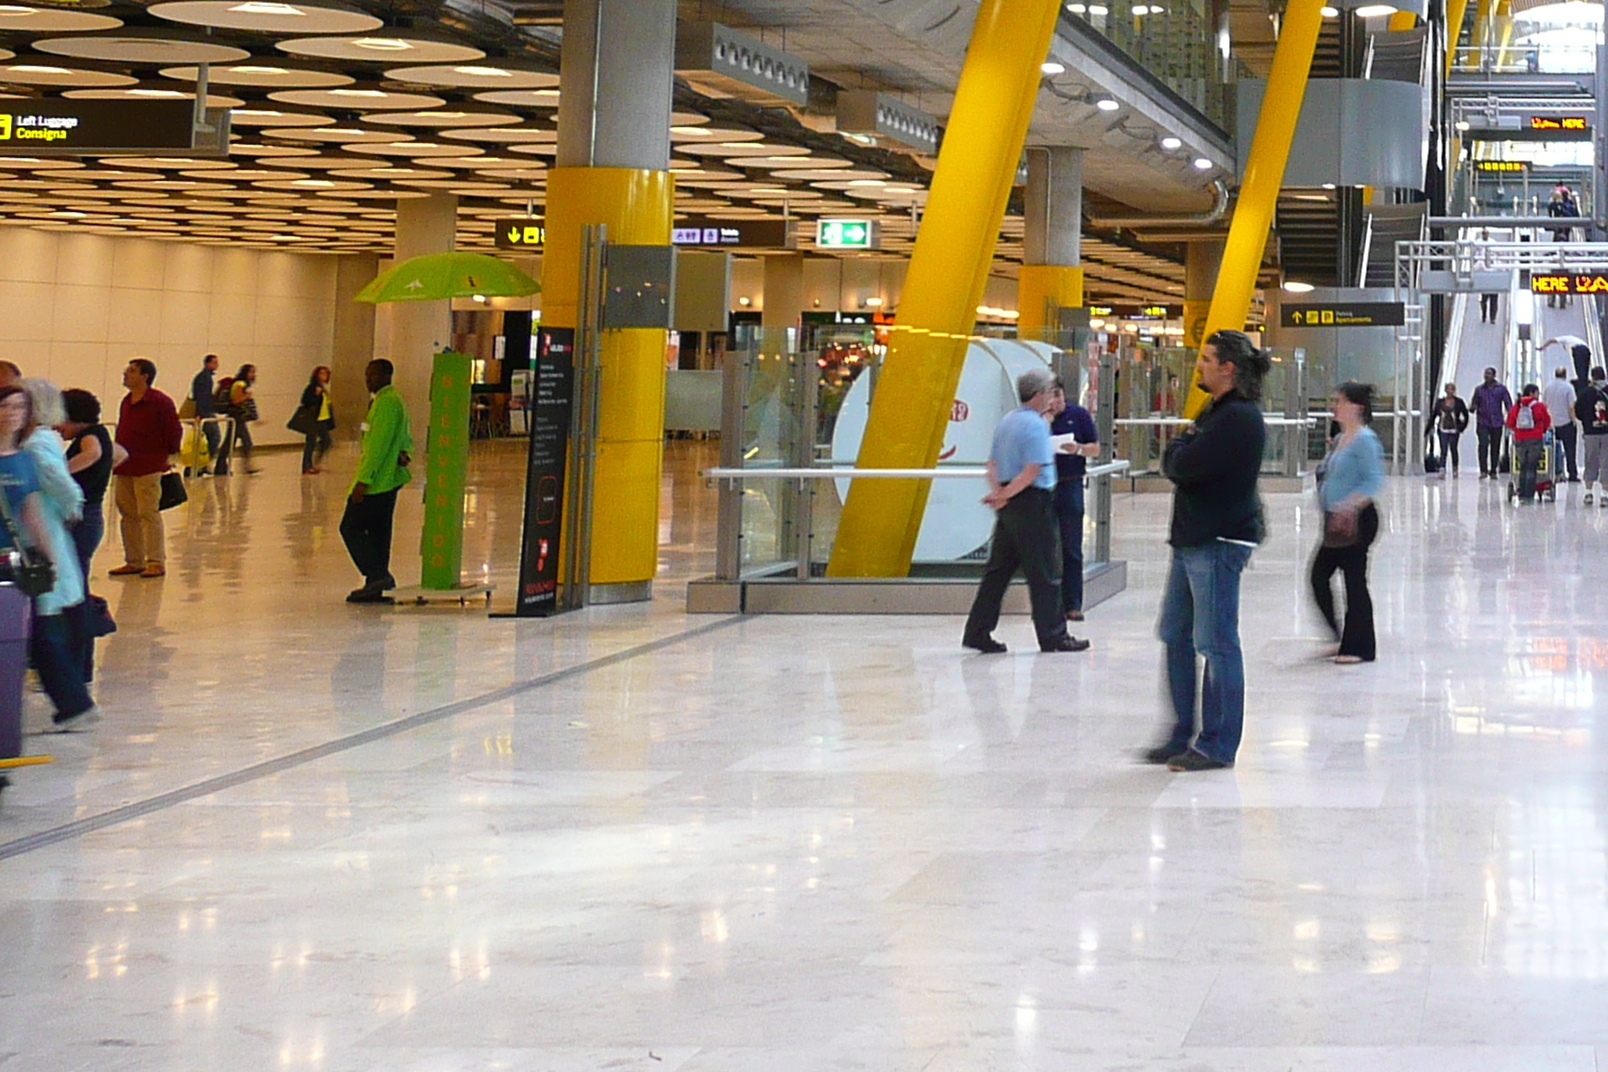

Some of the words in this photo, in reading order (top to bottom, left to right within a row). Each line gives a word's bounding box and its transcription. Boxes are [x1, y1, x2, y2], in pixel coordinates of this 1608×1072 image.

[17, 115, 36, 126] Left
[38, 115, 78, 128] Luggage
[1562, 117, 1585, 129] HERE
[16, 127, 67, 141] Consigna
[1532, 276, 1569, 292] HERE
[432, 375, 453, 567] BIENVENIDO
